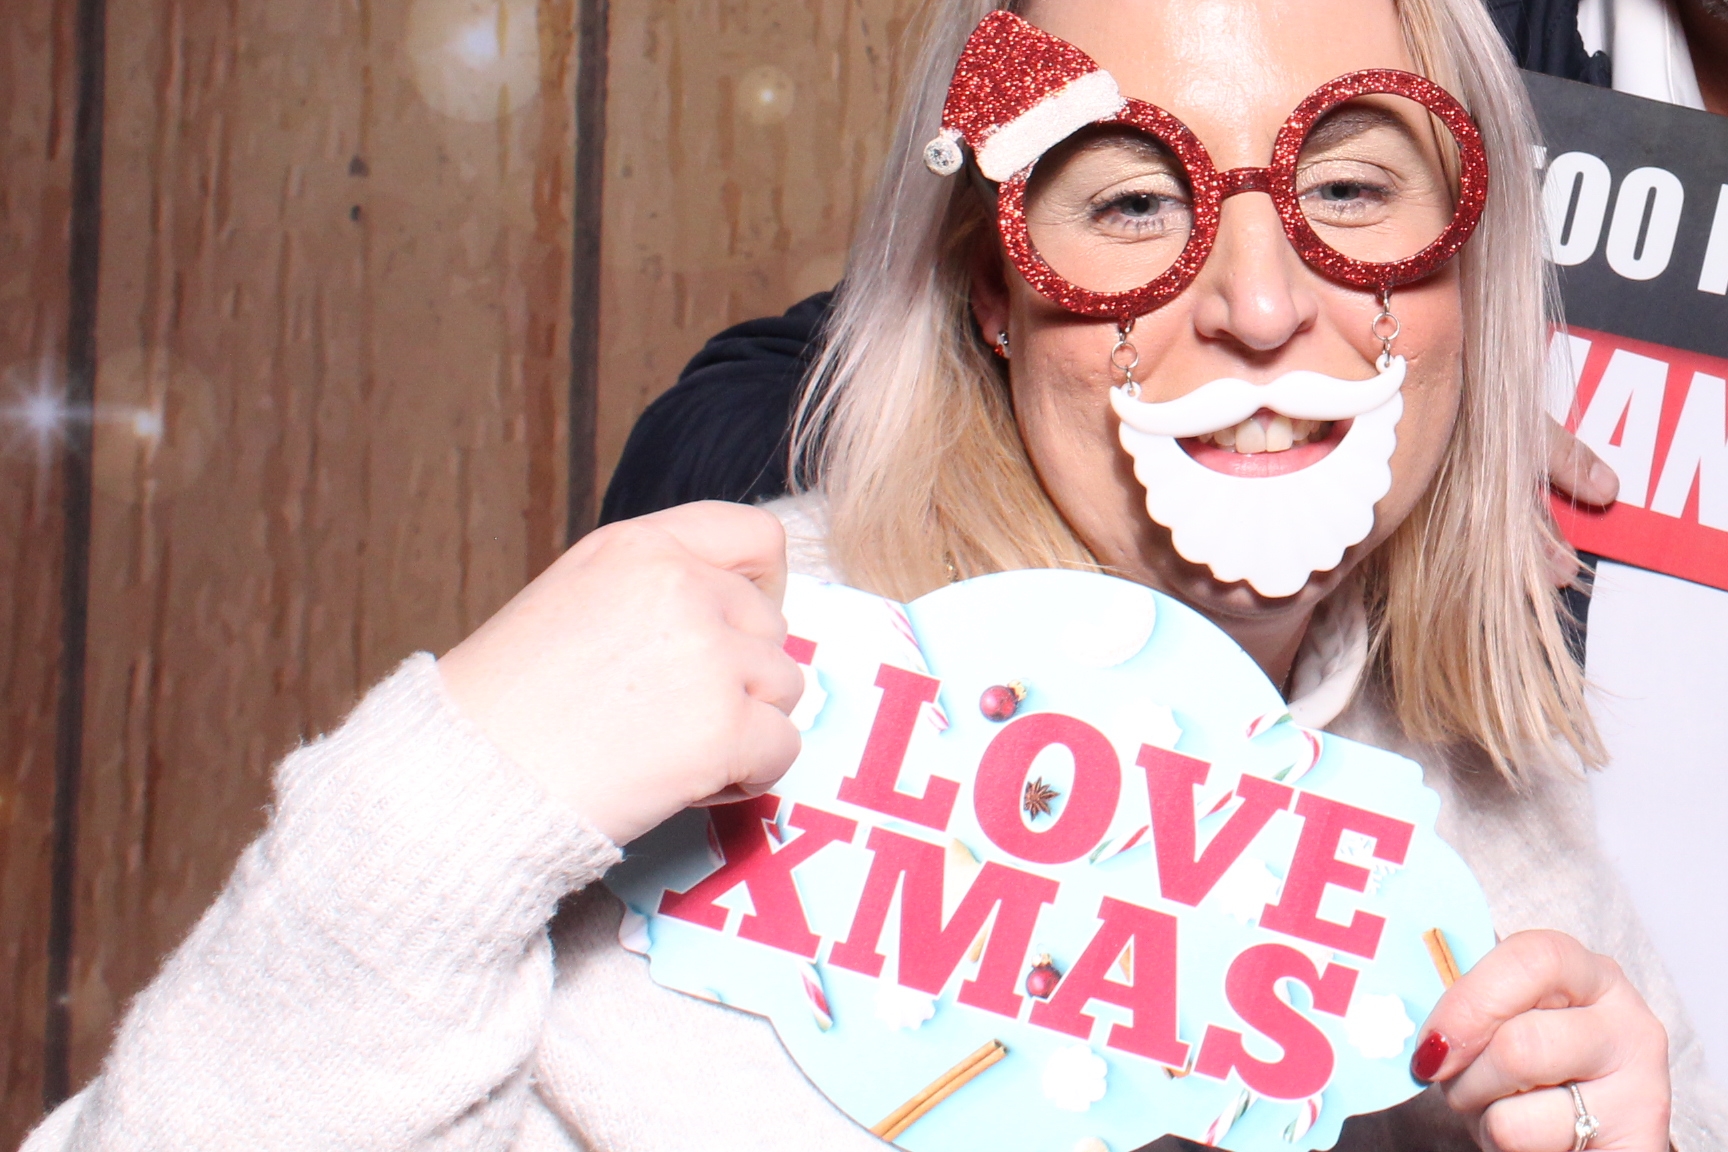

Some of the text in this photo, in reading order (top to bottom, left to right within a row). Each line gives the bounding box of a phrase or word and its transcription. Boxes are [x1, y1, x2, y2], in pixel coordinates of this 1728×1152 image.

[1528, 145, 1684, 281] OO
[657, 793, 1360, 1101] XMAS
[837, 663, 1416, 960] LOVE
